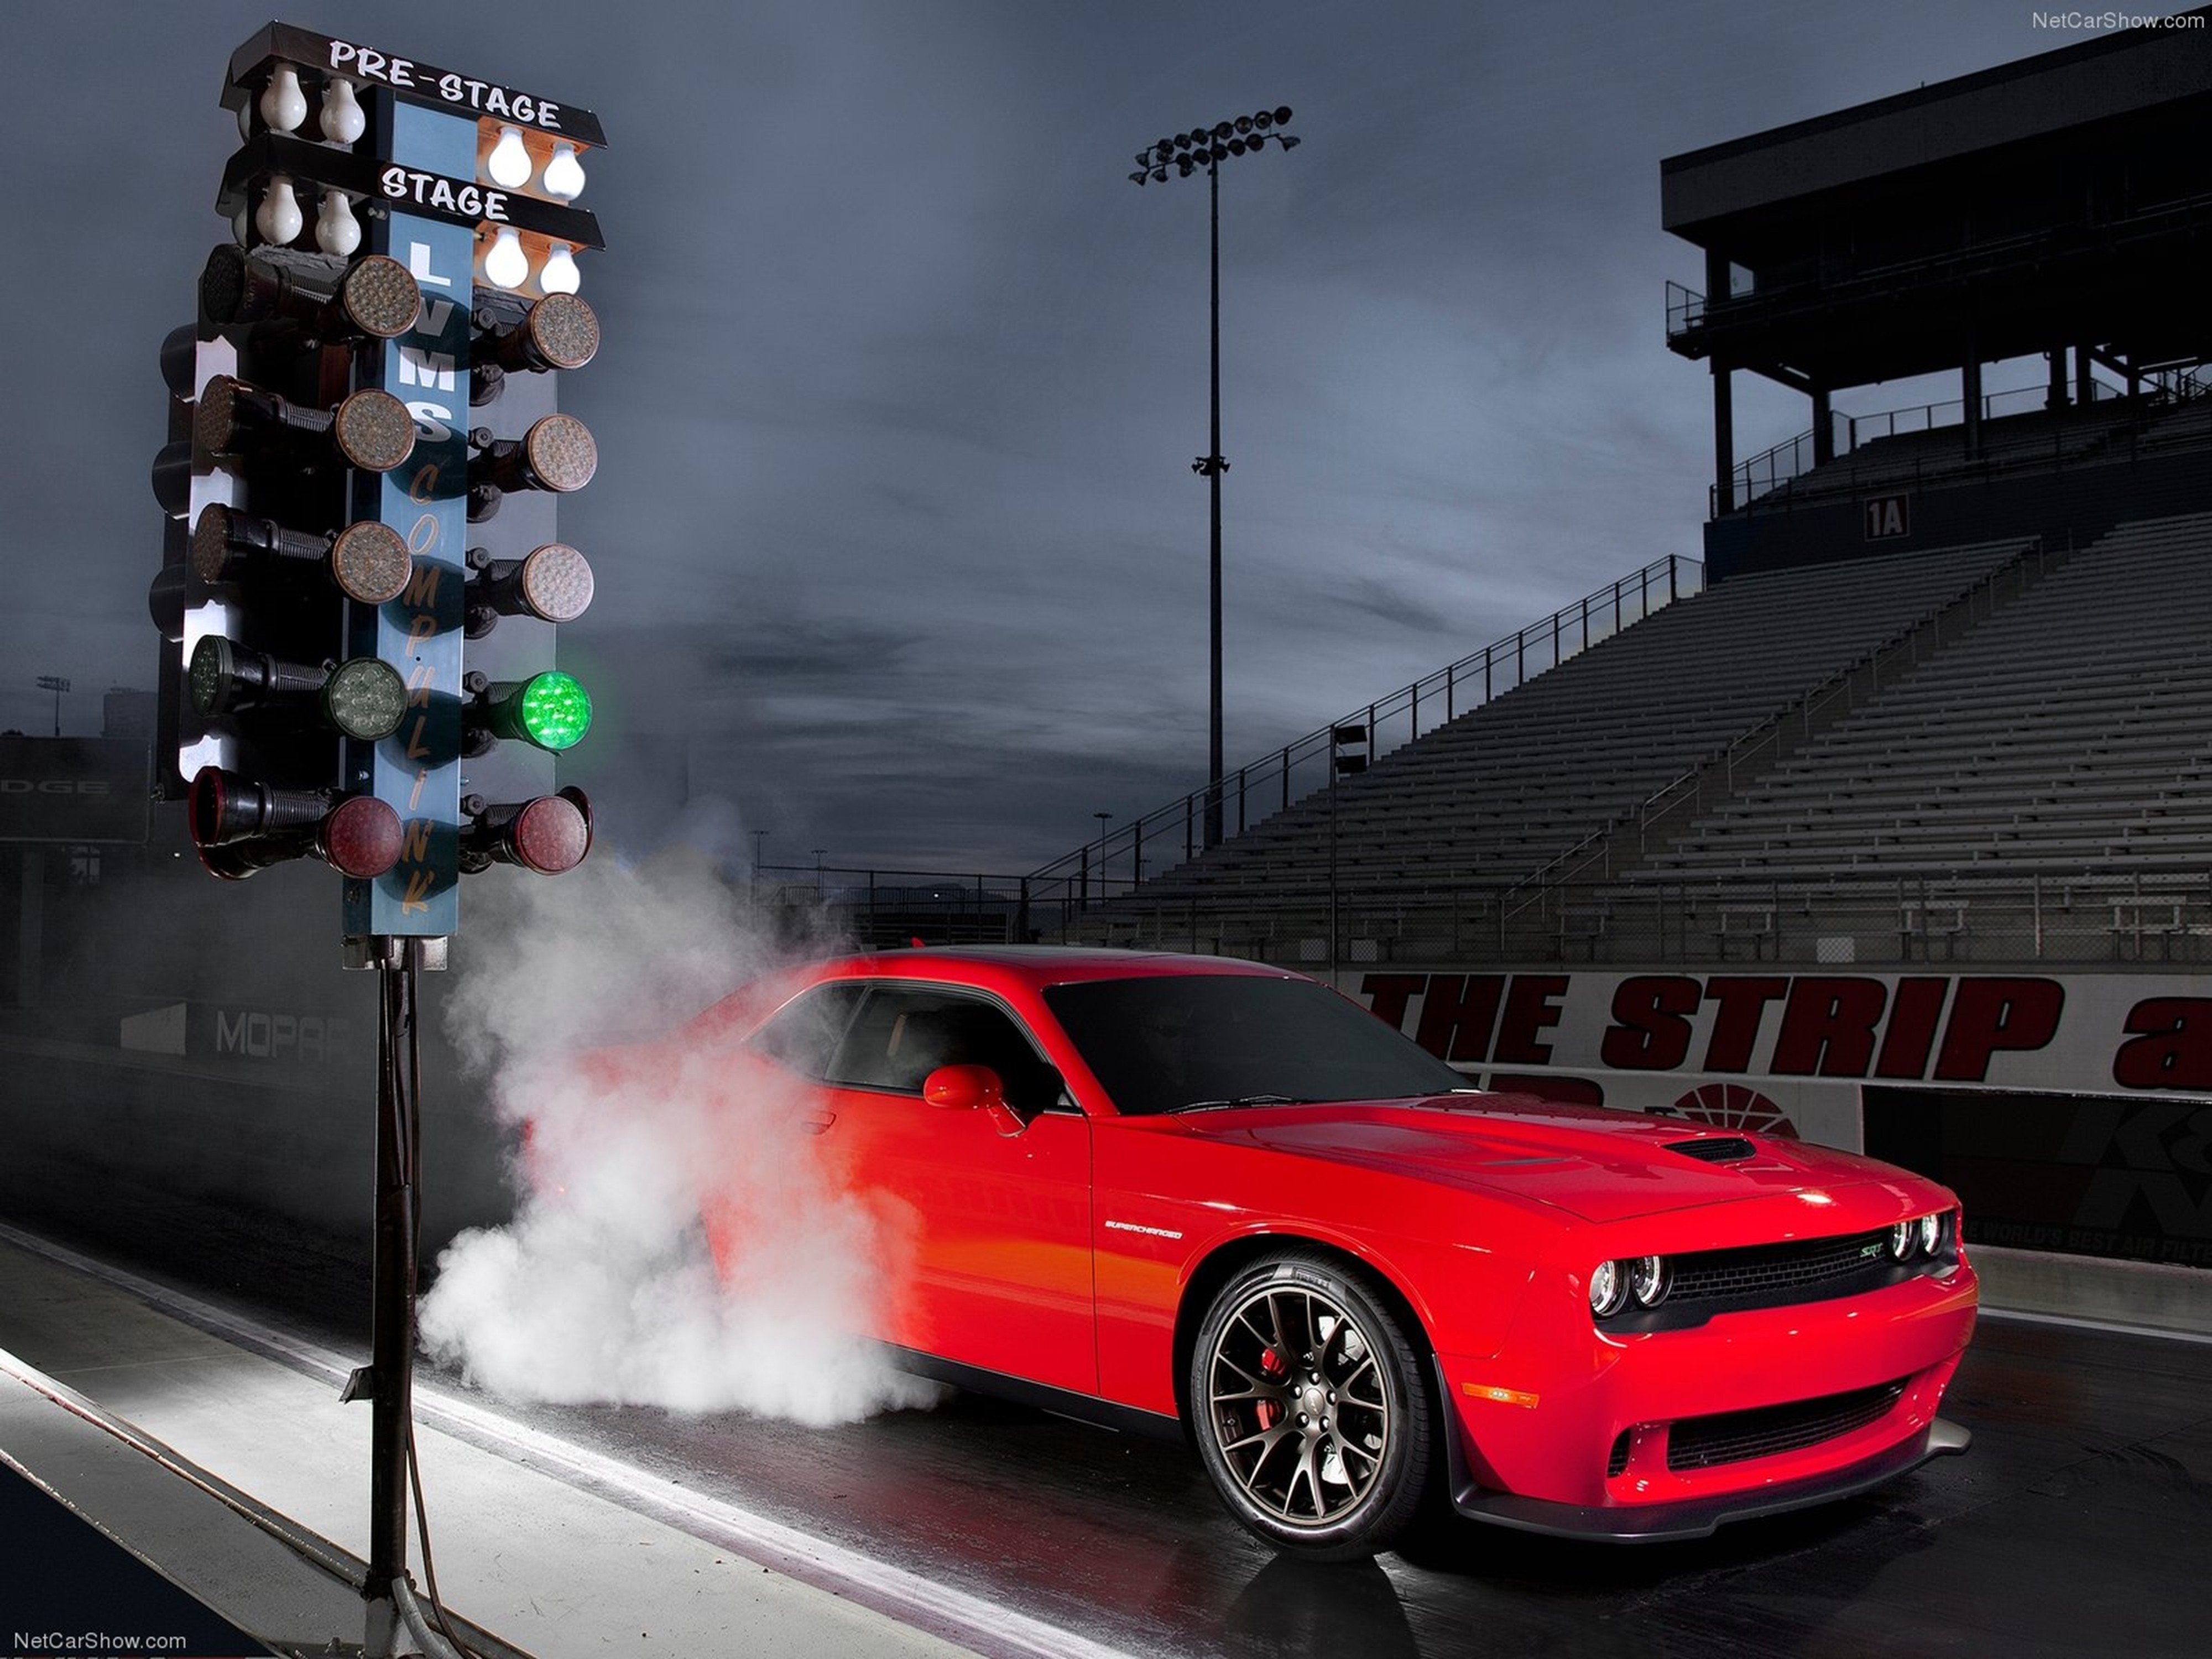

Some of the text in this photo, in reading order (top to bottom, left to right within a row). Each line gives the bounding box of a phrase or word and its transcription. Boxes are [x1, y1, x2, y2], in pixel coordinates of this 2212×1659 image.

[328, 40, 561, 129] PRE-STAGE
[382, 167, 509, 221] STAGE
[399, 242, 455, 441] LVMS
[1869, 499, 1903, 536] 1A
[1360, 973, 1571, 1065] THE
[1600, 975, 2065, 1082] STRIP
